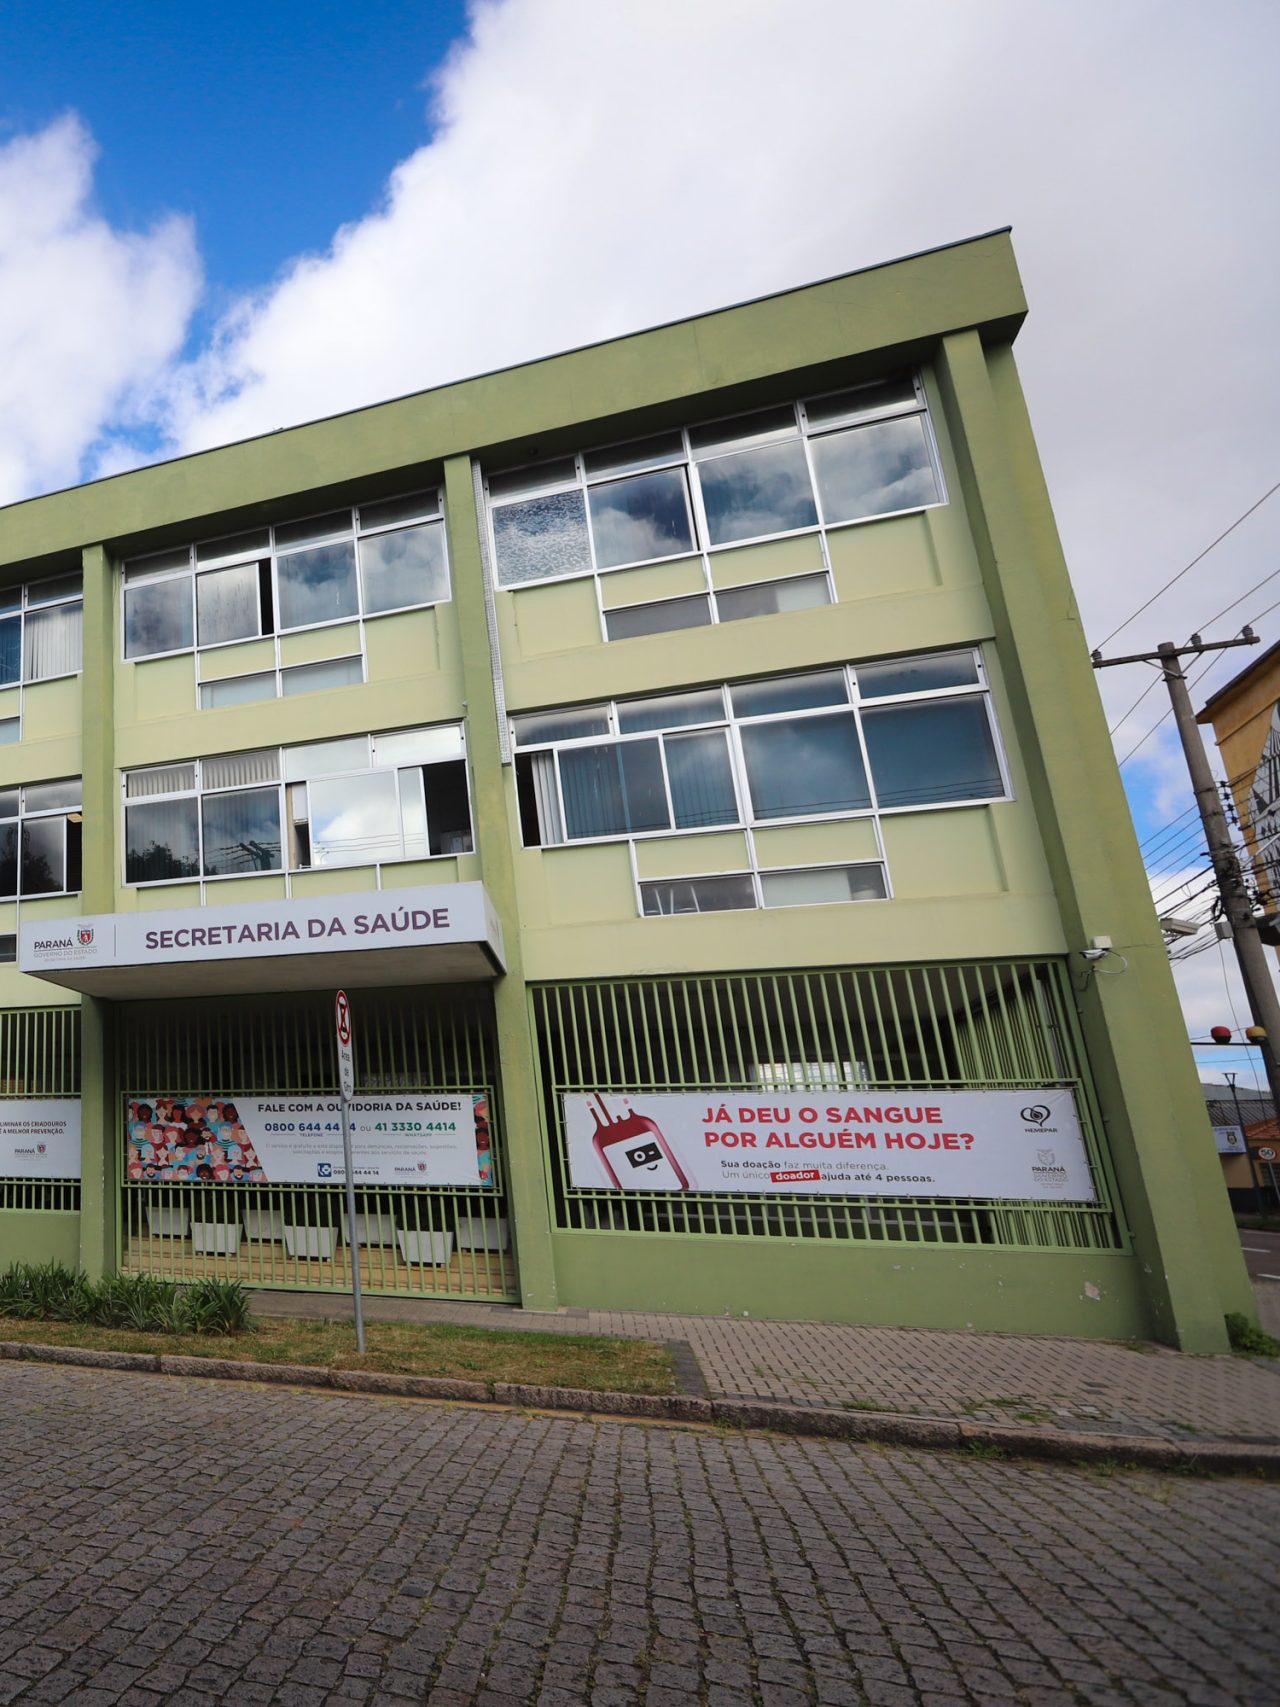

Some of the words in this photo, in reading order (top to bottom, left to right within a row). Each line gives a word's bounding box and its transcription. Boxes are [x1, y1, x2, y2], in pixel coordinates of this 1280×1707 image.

[145, 920, 300, 949] SECRETARIA
[307, 916, 346, 938] DA
[353, 906, 450, 934] SAÚDE
[33, 937, 74, 950] PARANÁ
[258, 1103, 286, 1112] FALE
[288, 1103, 313, 1112] COM
[316, 1103, 324, 1111] A
[396, 1102, 413, 1111] DA
[416, 1099, 461, 1111] SAÚDE!
[702, 1103, 733, 1124] JÁ
[738, 1108, 791, 1124] DEU
[798, 1107, 818, 1123] O
[826, 1107, 943, 1124] SANGUE
[31, 1120, 67, 1128] CRIADOUROS
[264, 1122, 295, 1131] 0800
[298, 1122, 321, 1131] 644
[324, 1122, 340, 1131] 44
[375, 1122, 388, 1132] 41
[391, 1122, 423, 1132] 3330
[426, 1122, 457, 1132] 4414
[30, 1127, 65, 1136] PREVENÇÃO.
[704, 1132, 758, 1148] POR
[765, 1128, 877, 1149] ALGUÉM
[884, 1132, 974, 1150] HOJE?
[721, 1160, 740, 1168] Sua
[742, 1160, 781, 1170] doação
[783, 1161, 799, 1169] faz
[803, 1161, 833, 1170] muita
[835, 1161, 889, 1172] diferença.
[722, 1171, 740, 1179] Um
[742, 1171, 770, 1180] único
[775, 1171, 815, 1181] doador
[821, 1172, 851, 1182] ajuda
[854, 1172, 872, 1181] até
[875, 1173, 883, 1181] 4
[886, 1174, 936, 1184] pessoas.
